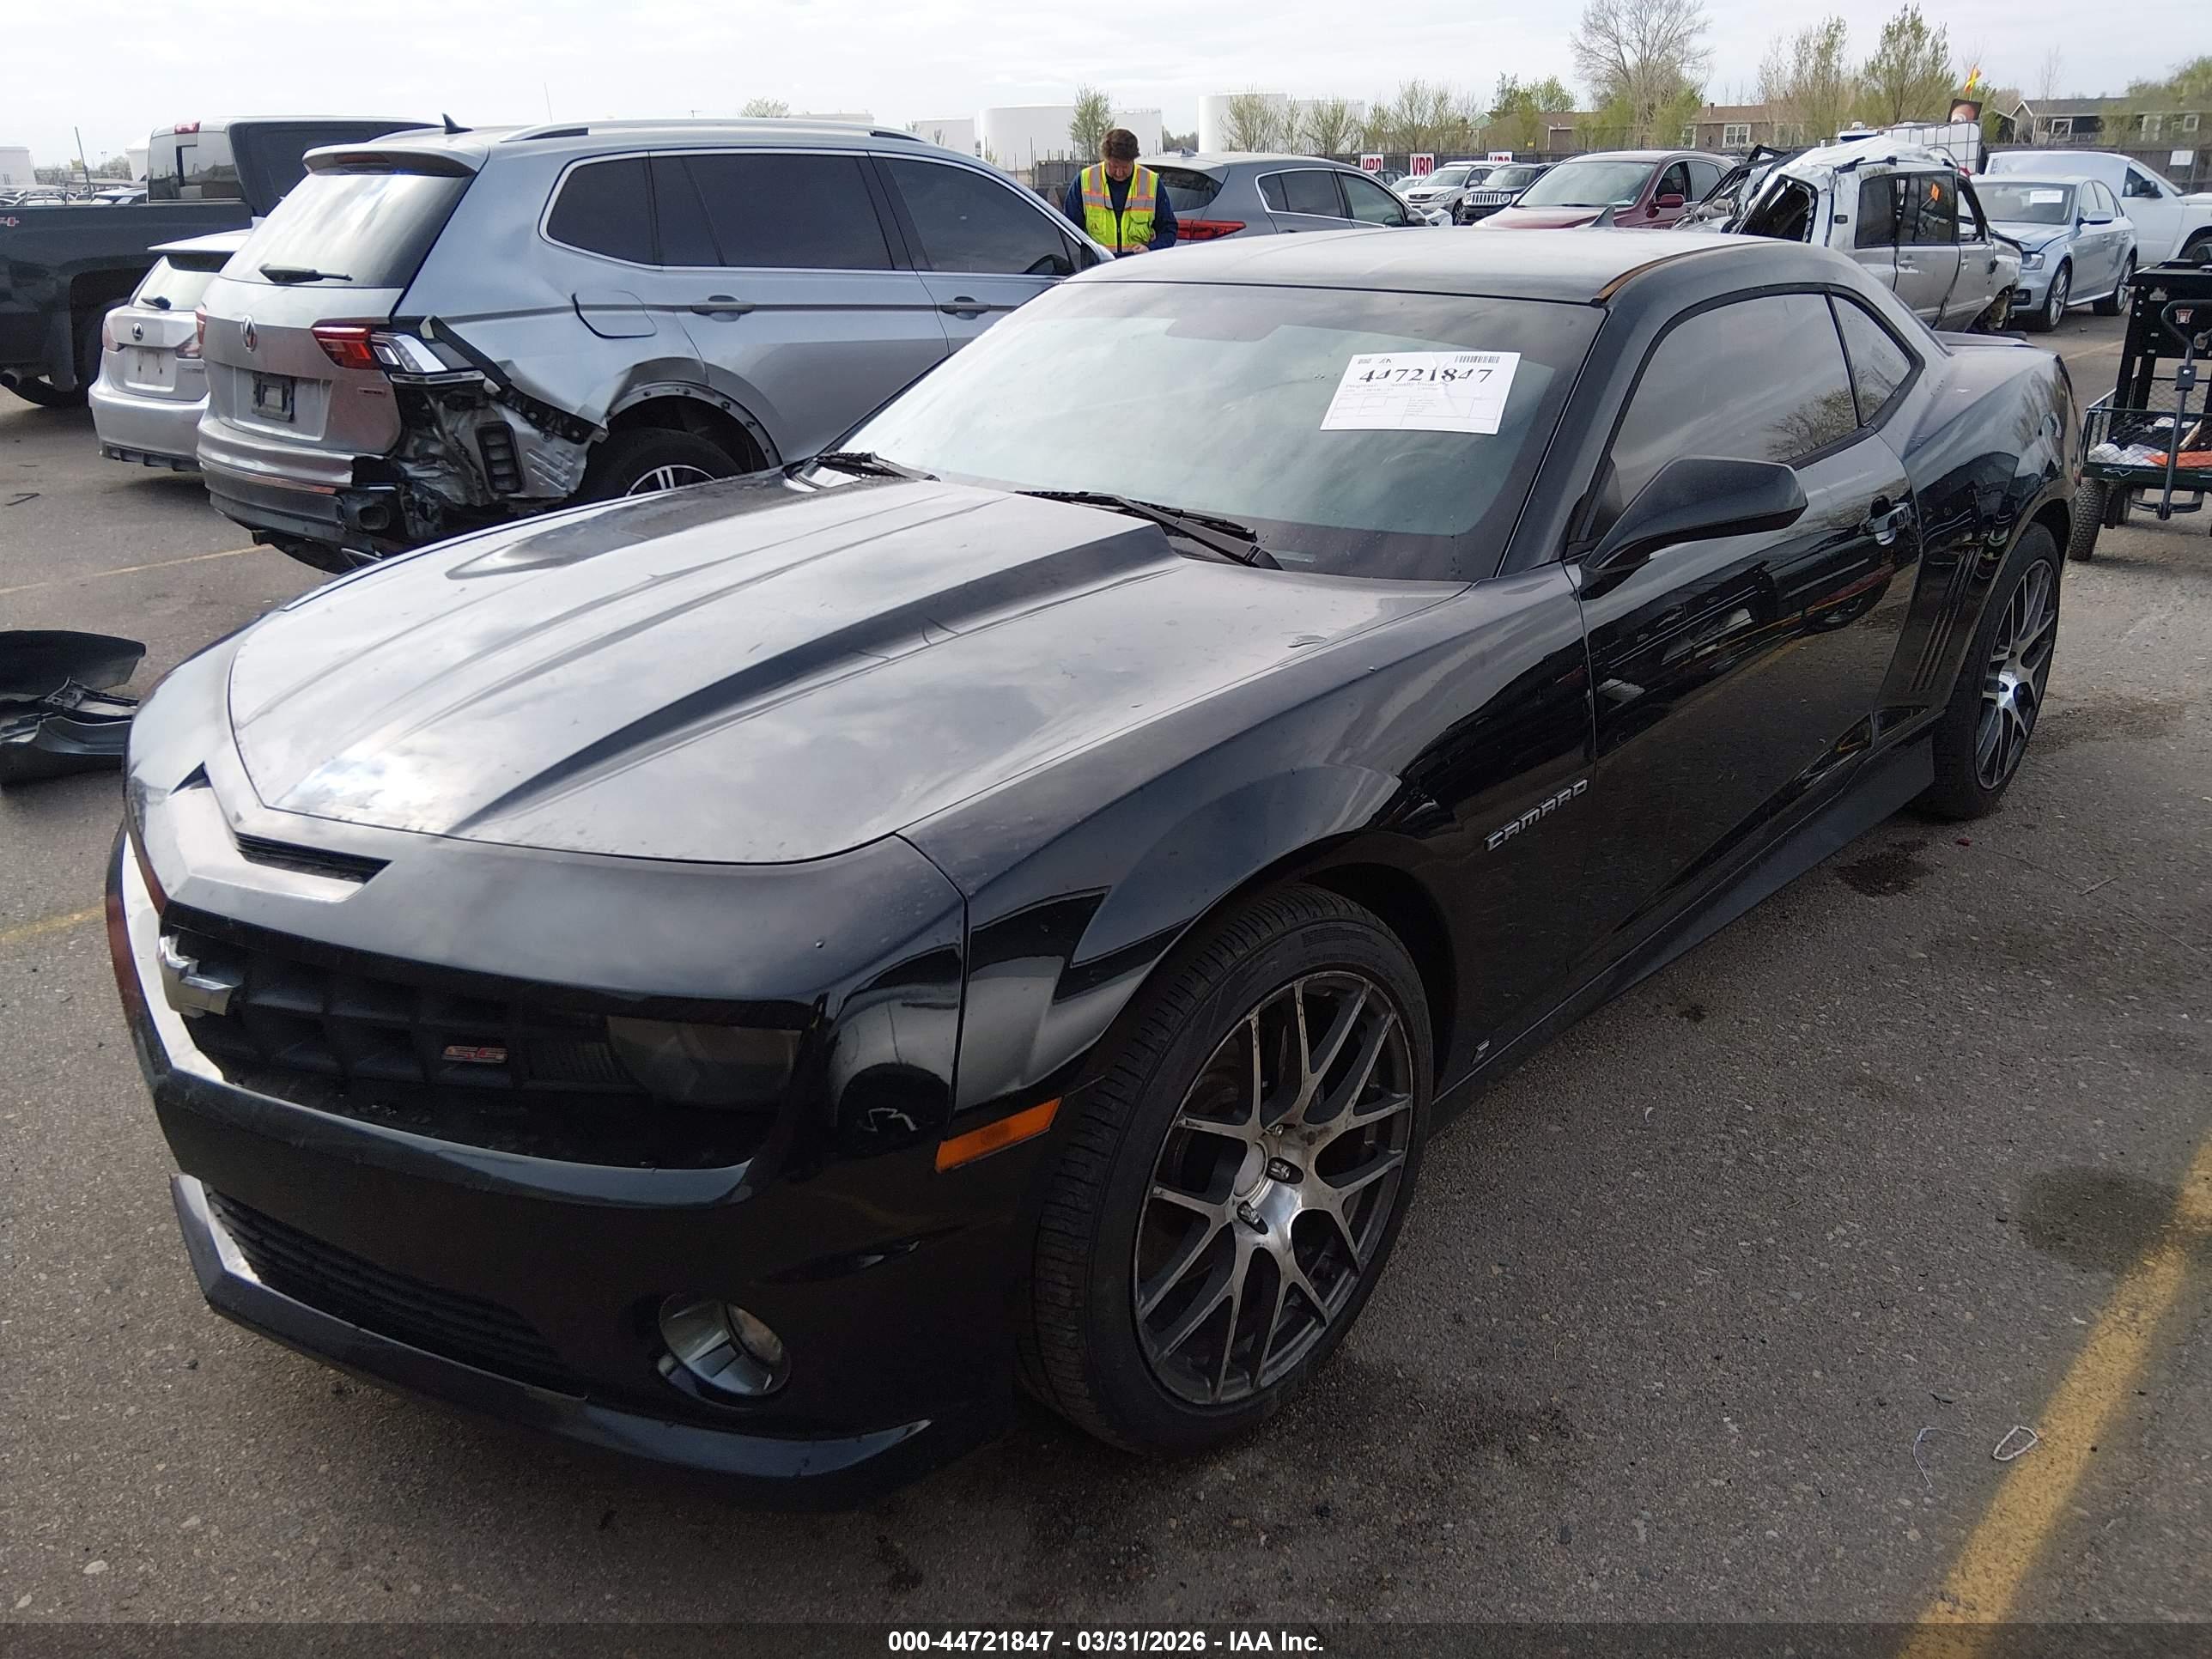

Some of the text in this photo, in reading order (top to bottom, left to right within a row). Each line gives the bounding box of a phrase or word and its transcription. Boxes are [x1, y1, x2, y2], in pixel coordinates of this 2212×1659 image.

[1412, 156, 1433, 177] VRD
[1359, 367, 1493, 383] 44721847
[1484, 779, 1588, 852] CAMARO
